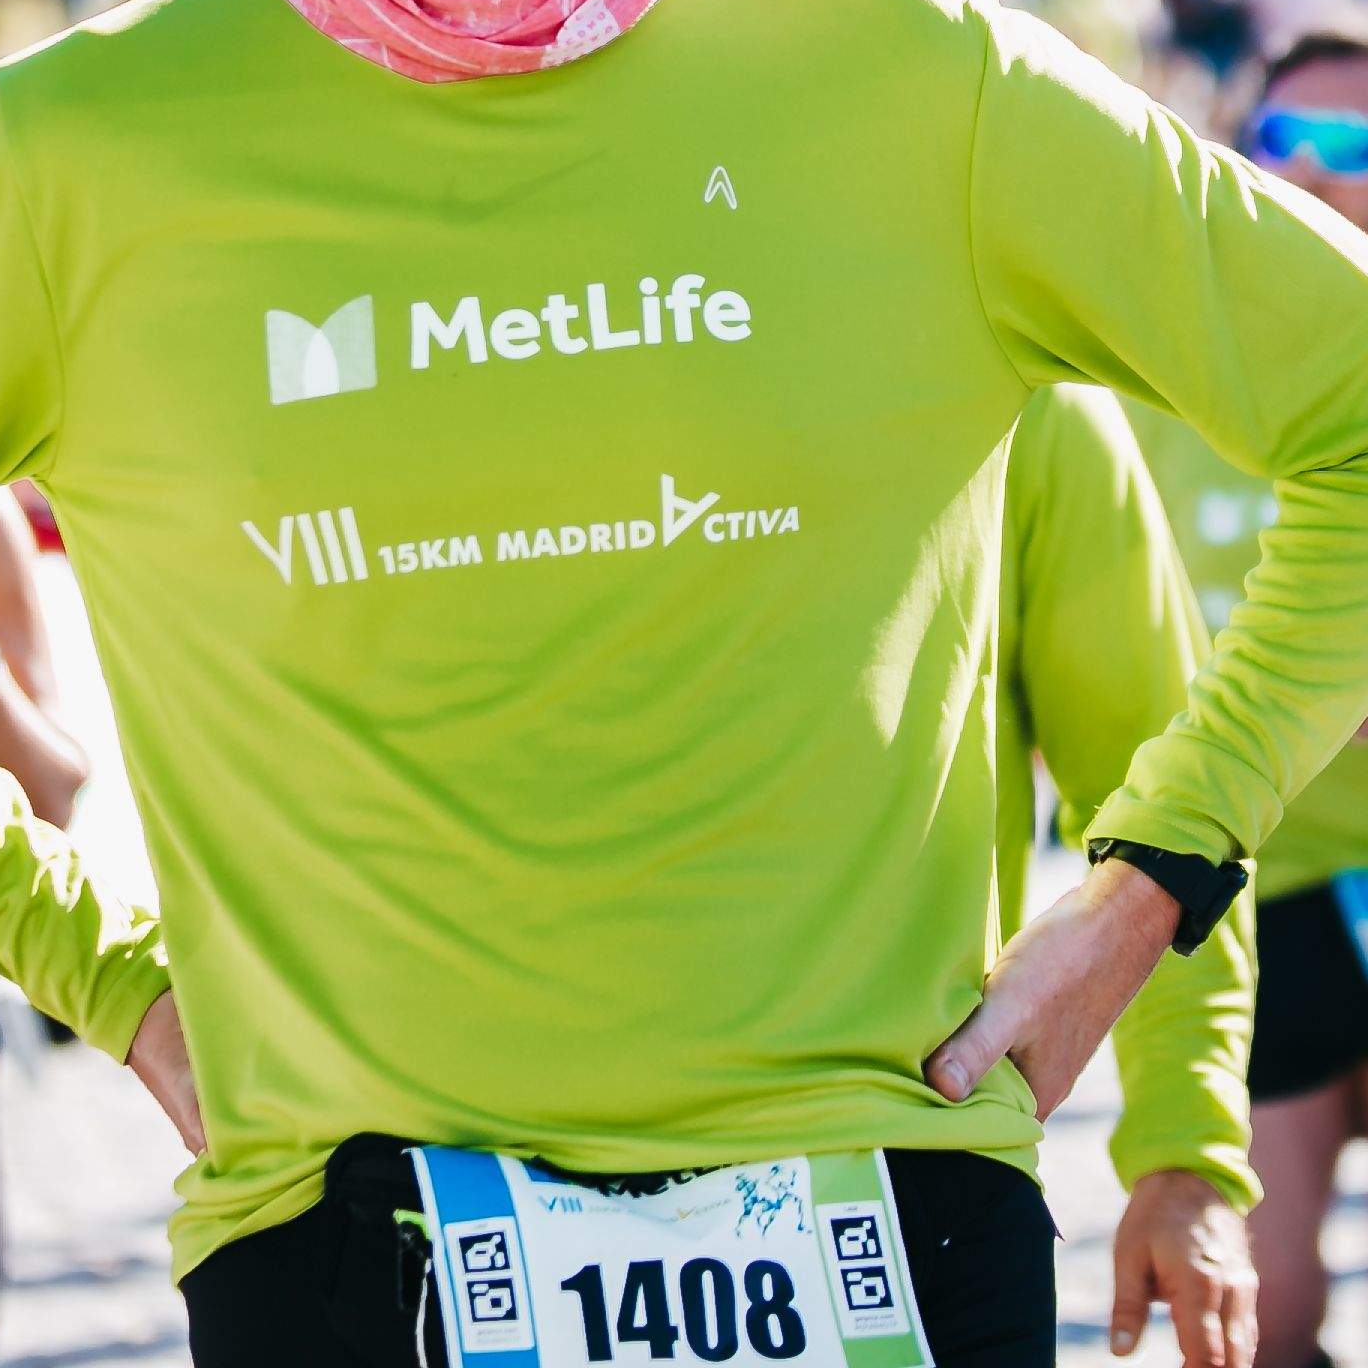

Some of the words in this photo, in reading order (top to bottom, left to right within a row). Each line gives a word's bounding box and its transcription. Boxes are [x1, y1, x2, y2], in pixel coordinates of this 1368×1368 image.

[410, 273, 752, 370] MetLife
[240, 506, 369, 586] VIII
[377, 534, 484, 575] 15KM
[496, 519, 656, 562] MADRID
[660, 473, 800, 547] ACTIVA
[537, 1194, 583, 1214] VIII
[560, 1256, 807, 1363] 1408
